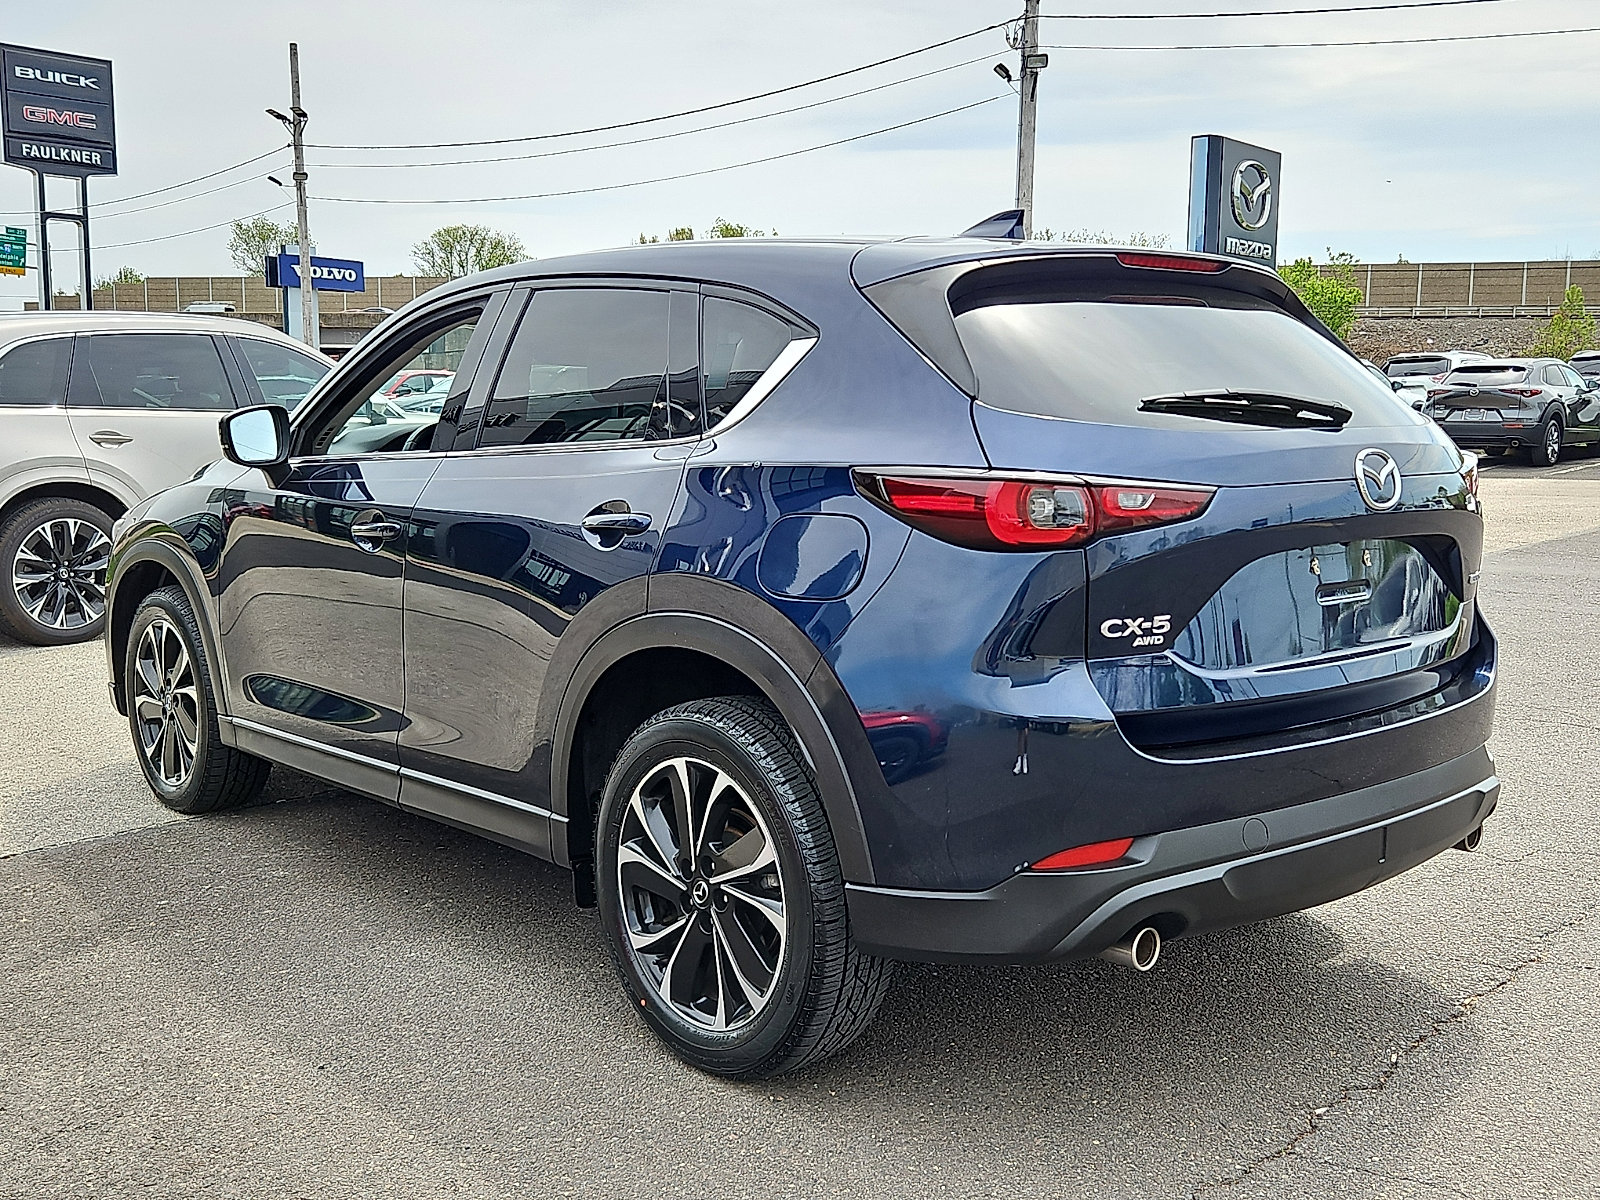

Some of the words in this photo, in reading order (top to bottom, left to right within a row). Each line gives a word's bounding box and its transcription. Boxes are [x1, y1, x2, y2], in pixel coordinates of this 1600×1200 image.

[14, 65, 101, 91] BUICK
[22, 105, 97, 130] GMC
[21, 143, 102, 166] FAULKNER
[291, 264, 356, 281] VOLVO
[1101, 615, 1171, 638] CX-5
[1132, 634, 1164, 648] AWD
